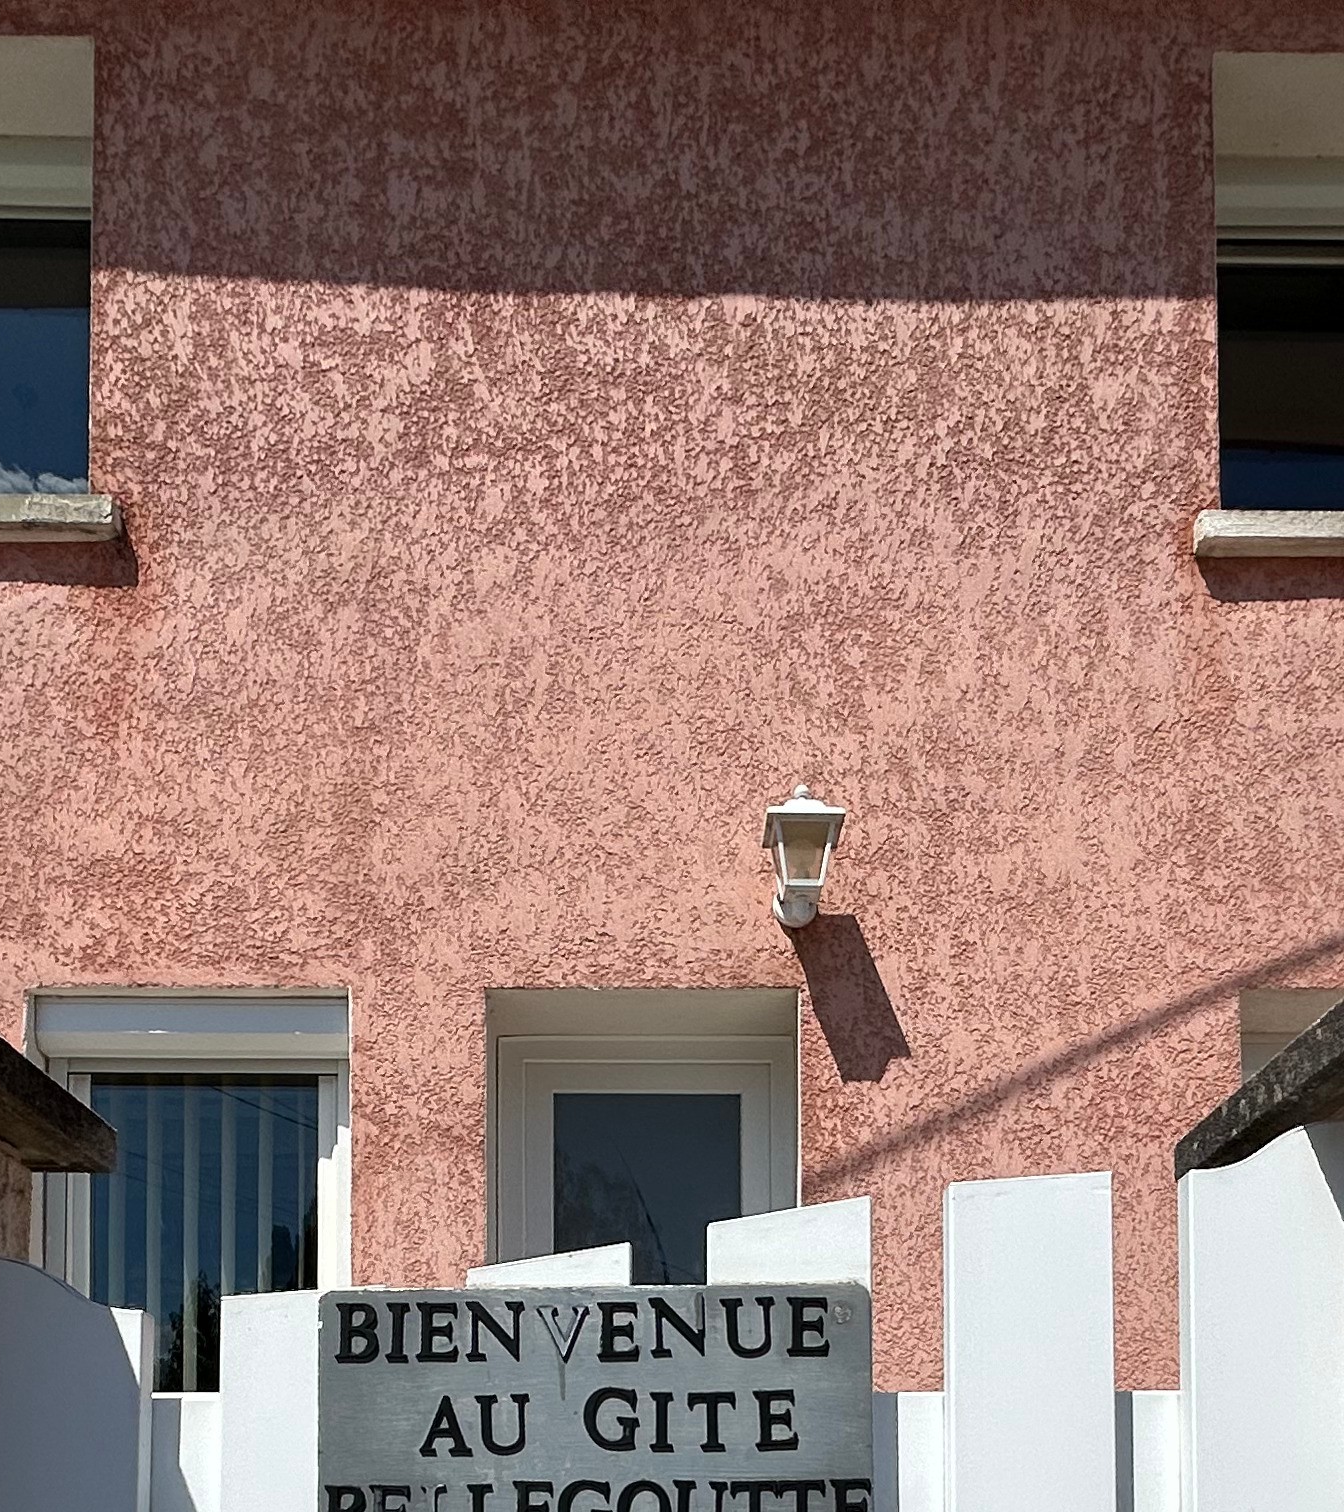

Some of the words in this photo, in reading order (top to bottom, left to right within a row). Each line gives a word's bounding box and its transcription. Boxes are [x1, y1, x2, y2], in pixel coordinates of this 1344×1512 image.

[334, 1296, 831, 1364] BIENVENUE
[419, 1394, 531, 1458] AU
[582, 1386, 800, 1454] GITE
